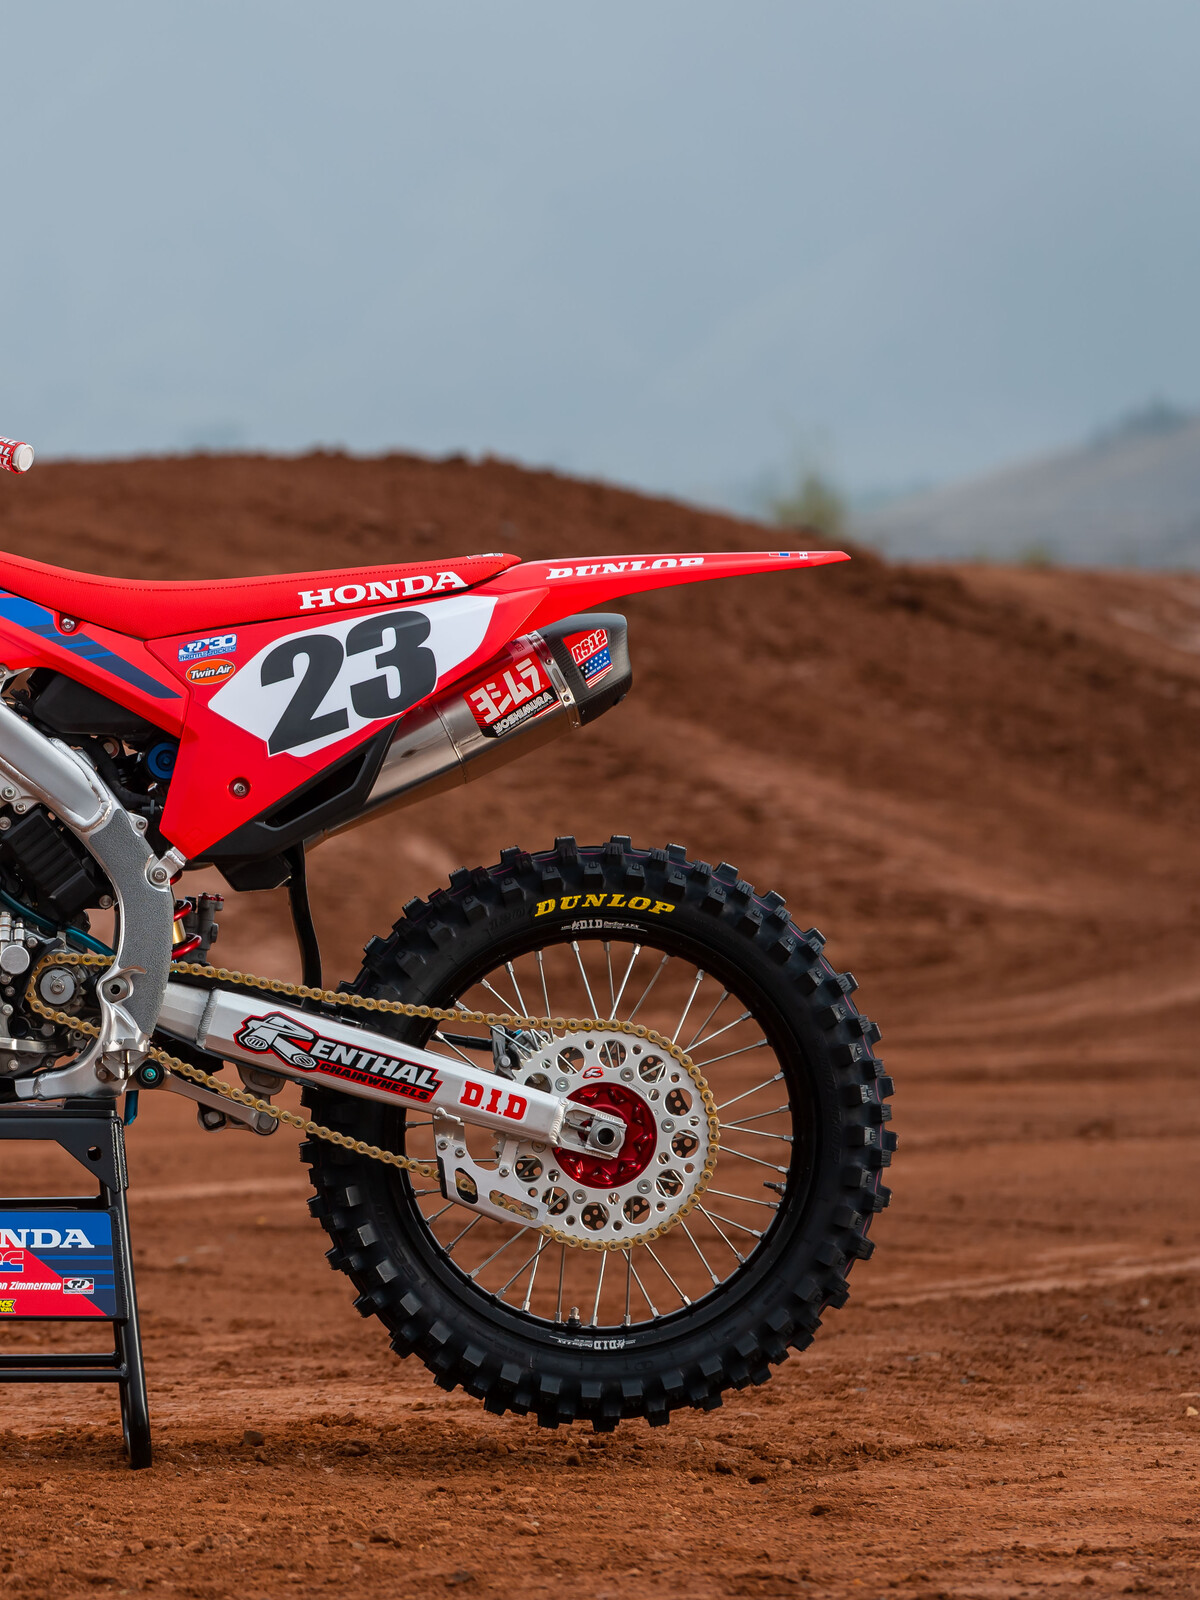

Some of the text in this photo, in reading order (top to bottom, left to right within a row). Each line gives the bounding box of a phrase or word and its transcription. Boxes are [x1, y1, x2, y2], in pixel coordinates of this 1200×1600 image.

[545, 557, 705, 580] DUNLOP
[298, 571, 468, 610] HONDA
[190, 664, 232, 680] Twin Air
[260, 610, 437, 756] 23
[492, 691, 554, 736] YOSHIMURA
[534, 893, 676, 917] DUNLOP
[319, 1061, 430, 1100] CHAINWHEELS
[459, 1080, 528, 1121] D.I.D
[8, 1281, 62, 1291] Zimmerman
